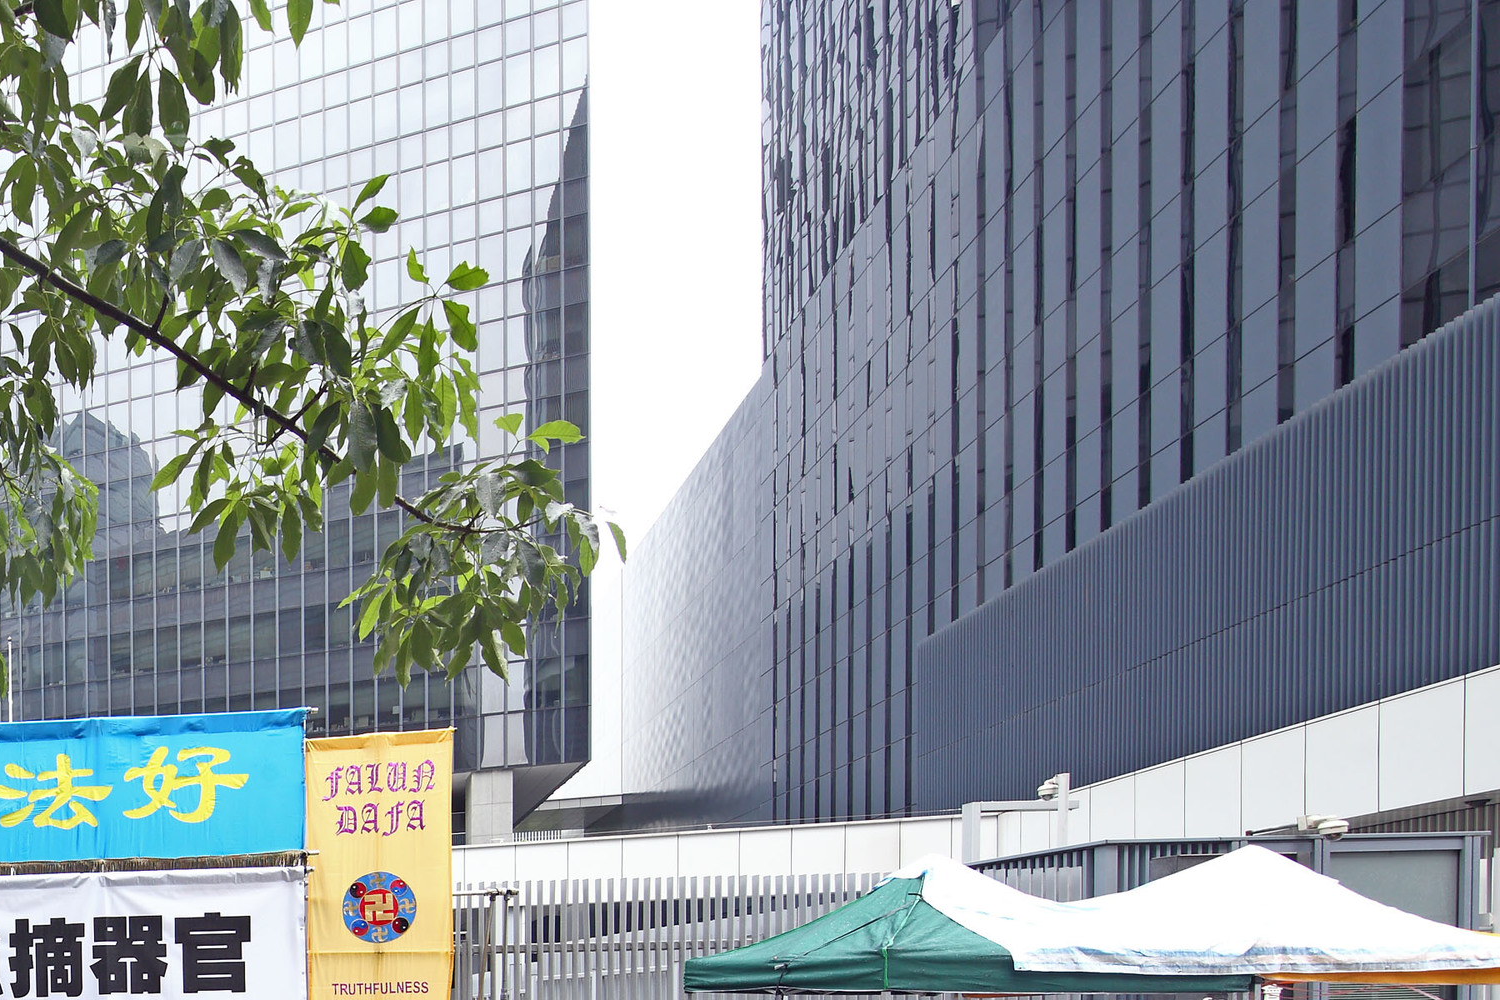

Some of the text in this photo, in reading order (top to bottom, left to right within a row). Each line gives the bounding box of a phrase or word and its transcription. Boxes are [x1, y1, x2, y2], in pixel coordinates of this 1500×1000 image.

[322, 759, 436, 801] FALUN
[335, 799, 426, 837] DAFA
[332, 981, 429, 996] TRUTHFULNESS
